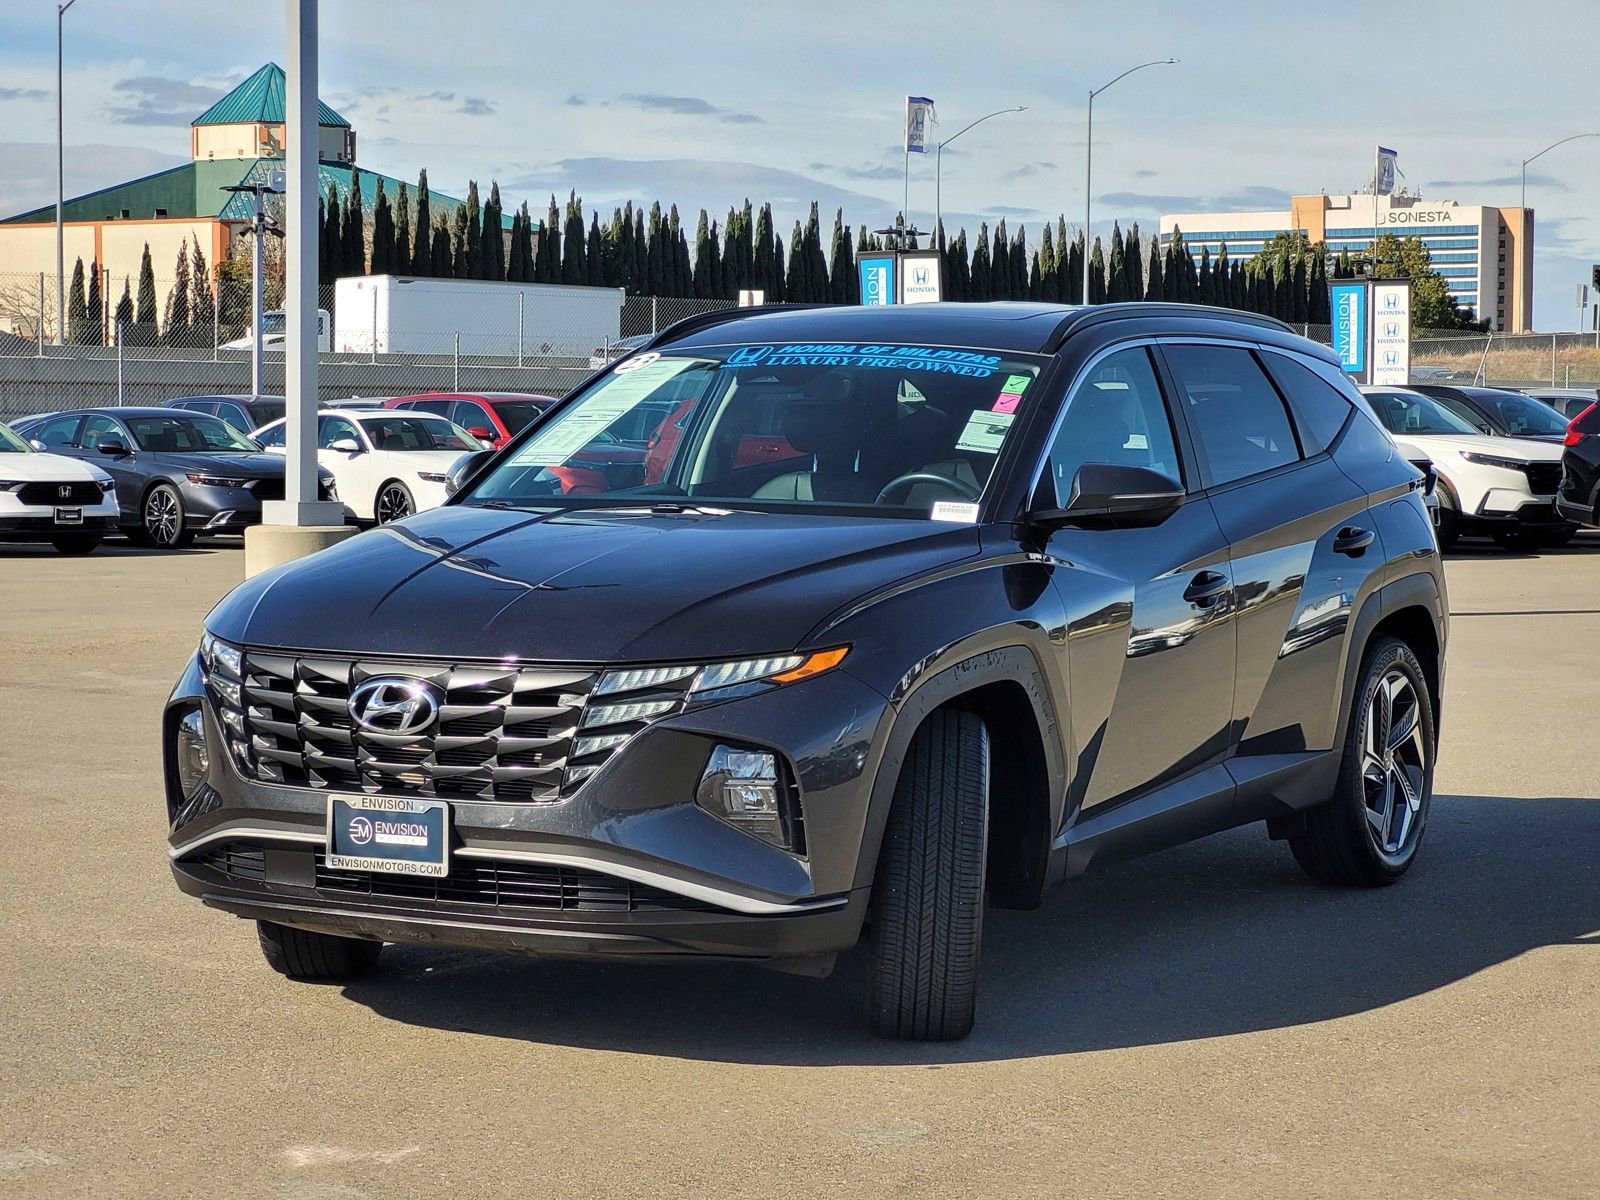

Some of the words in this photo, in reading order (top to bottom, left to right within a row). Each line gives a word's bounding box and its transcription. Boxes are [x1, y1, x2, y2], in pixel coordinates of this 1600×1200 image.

[1388, 211, 1452, 223] SONESTA
[1339, 293, 1350, 365] ENVISION
[776, 345, 857, 354] HONDA
[859, 345, 895, 354] OF
[894, 347, 1001, 365] MILPITAS
[764, 356, 856, 366] LUXURY
[855, 357, 992, 378] PRE-OWNED
[1359, 687, 1373, 745] KUMHO
[361, 797, 414, 811] ENVISION
[375, 821, 428, 837] ENVISION
[331, 857, 442, 875] ENVISIONMOTORS.COM
